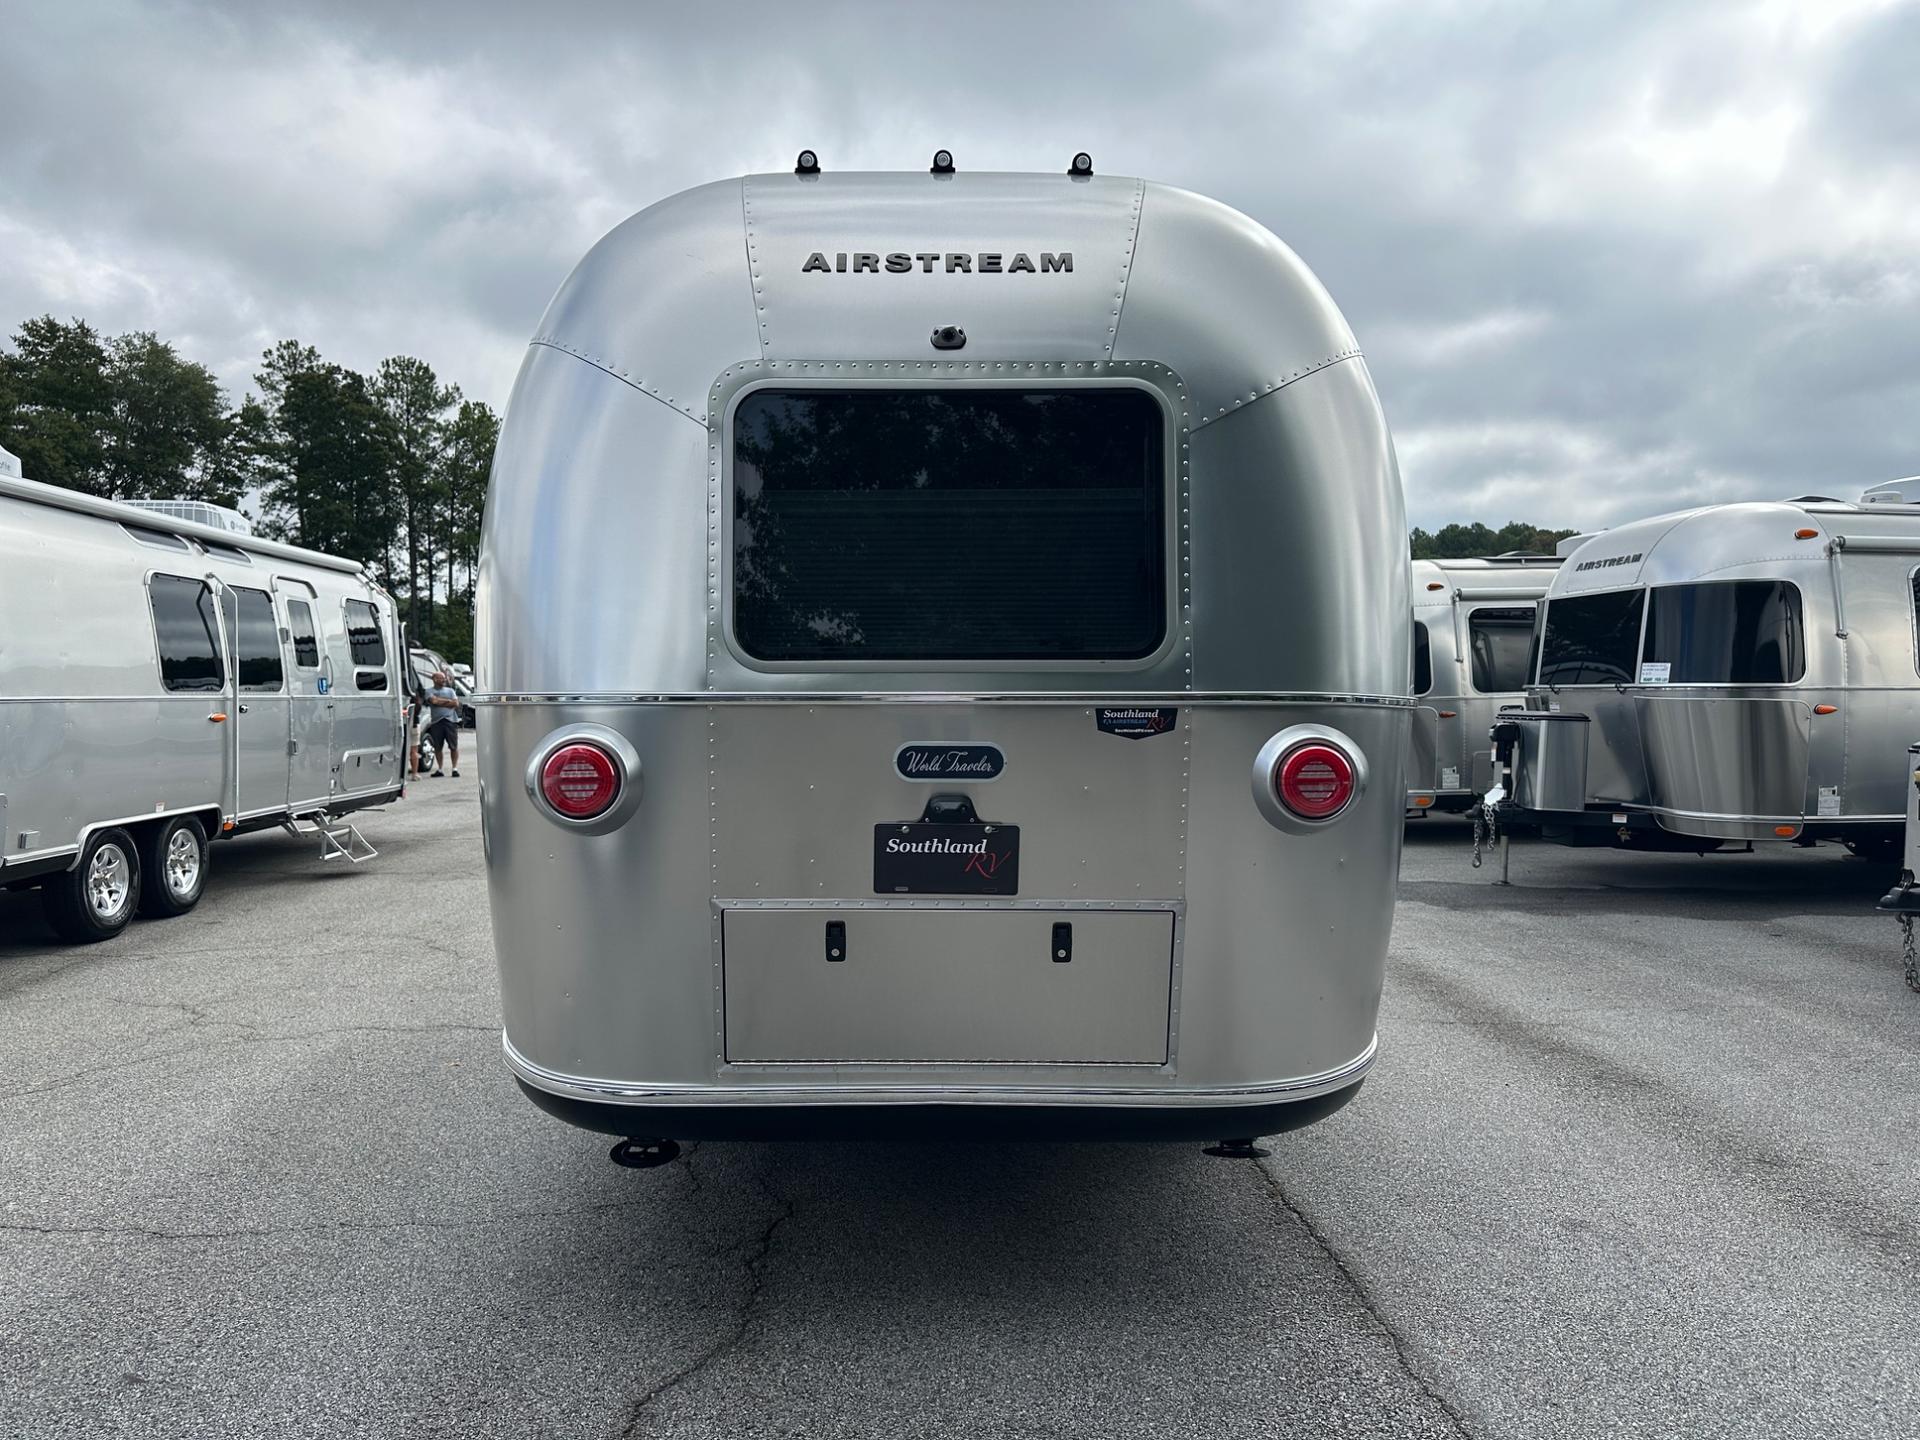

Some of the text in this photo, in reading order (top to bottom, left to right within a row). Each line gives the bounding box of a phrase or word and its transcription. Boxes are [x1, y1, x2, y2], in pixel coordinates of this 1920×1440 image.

[801, 252, 1073, 273] AIRSTREAM
[1575, 553, 1643, 571] AIRSTREAM
[1103, 709, 1159, 718] Southland
[1146, 716, 1172, 732] RV
[906, 751, 993, 772] World Traveler
[886, 838, 988, 853] Southland
[964, 850, 1012, 879] RV
